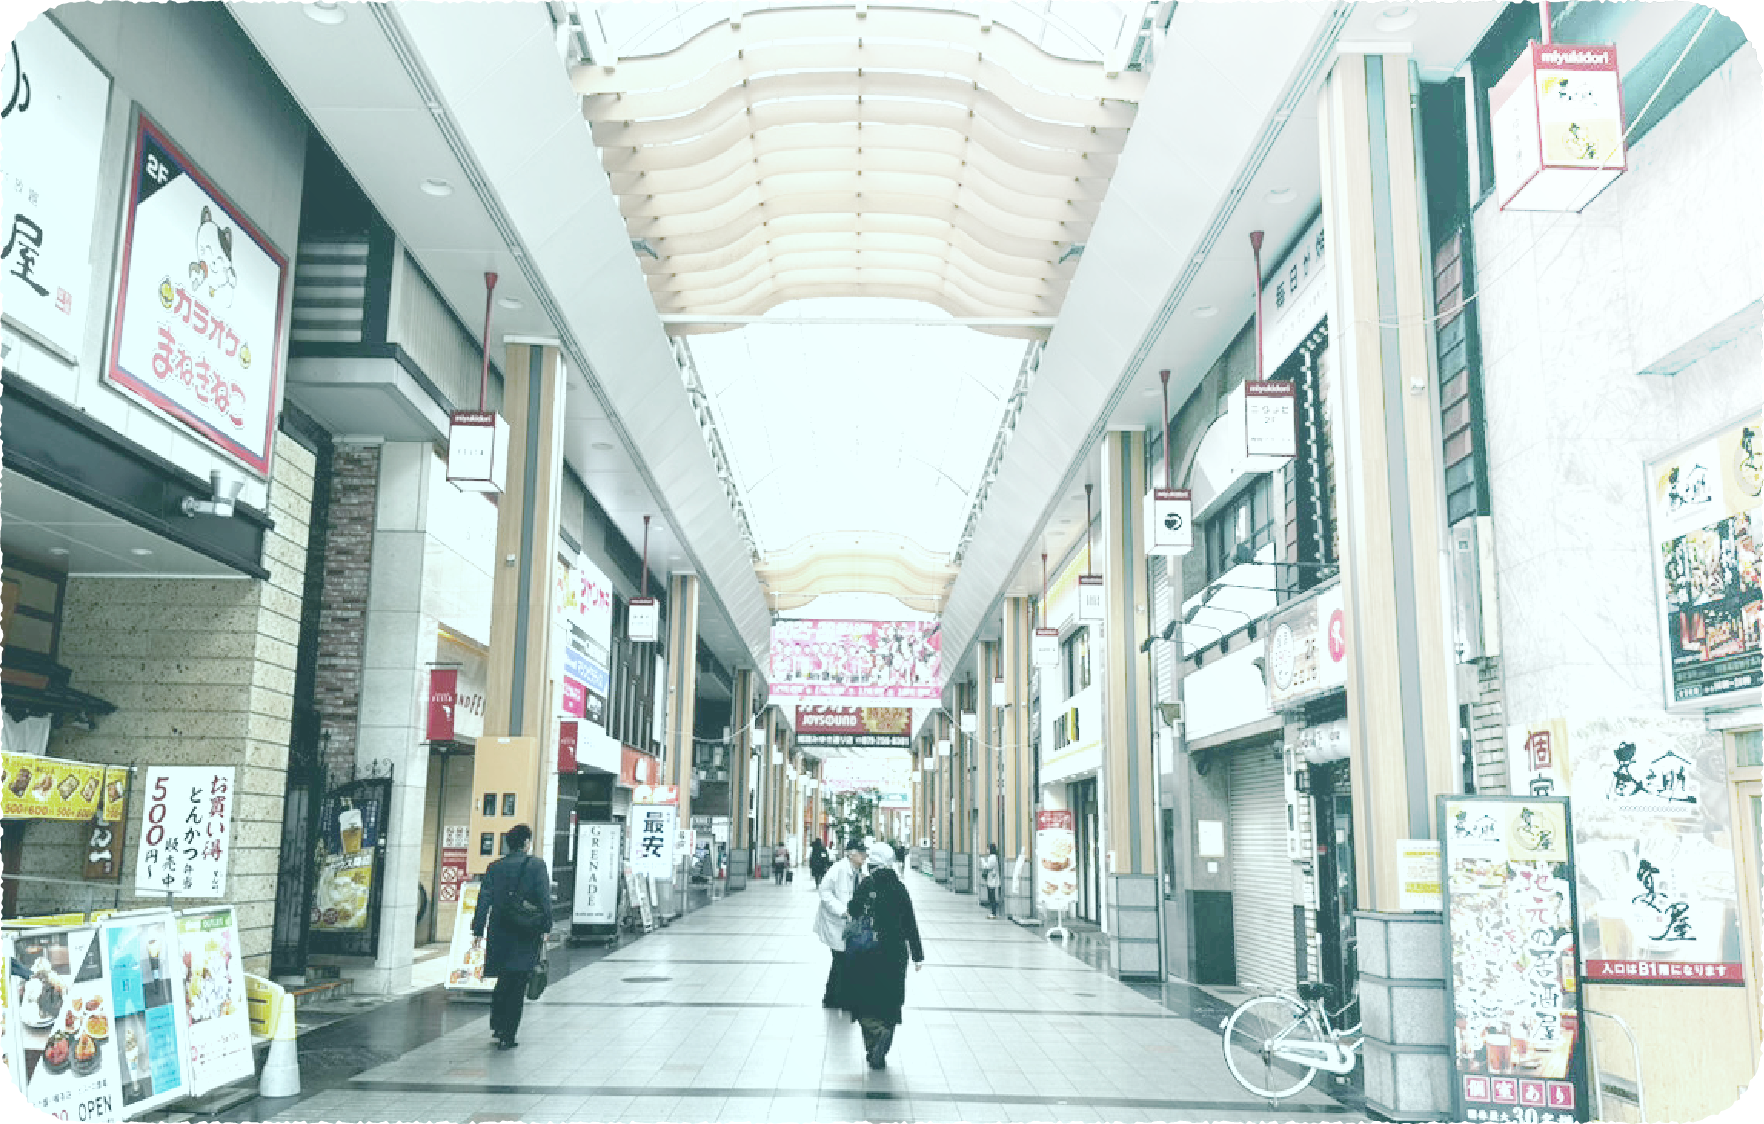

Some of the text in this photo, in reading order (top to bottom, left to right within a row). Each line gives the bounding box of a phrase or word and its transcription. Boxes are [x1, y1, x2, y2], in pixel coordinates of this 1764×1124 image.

[1541, 50, 1609, 66] miyukidori
[145, 153, 169, 185] 2F
[173, 287, 240, 357] カラオケ
[152, 324, 246, 430] まねきねこ
[802, 715, 856, 727] JOYSOUND
[201, 774, 229, 862] お買い得
[643, 811, 664, 858] 最安
[587, 826, 602, 907] GRENADE
[1521, 863, 1561, 1044] 地元の居酒屋
[79, 1094, 112, 1122] OPEN
[1468, 1079, 1564, 1103] 個室あり
